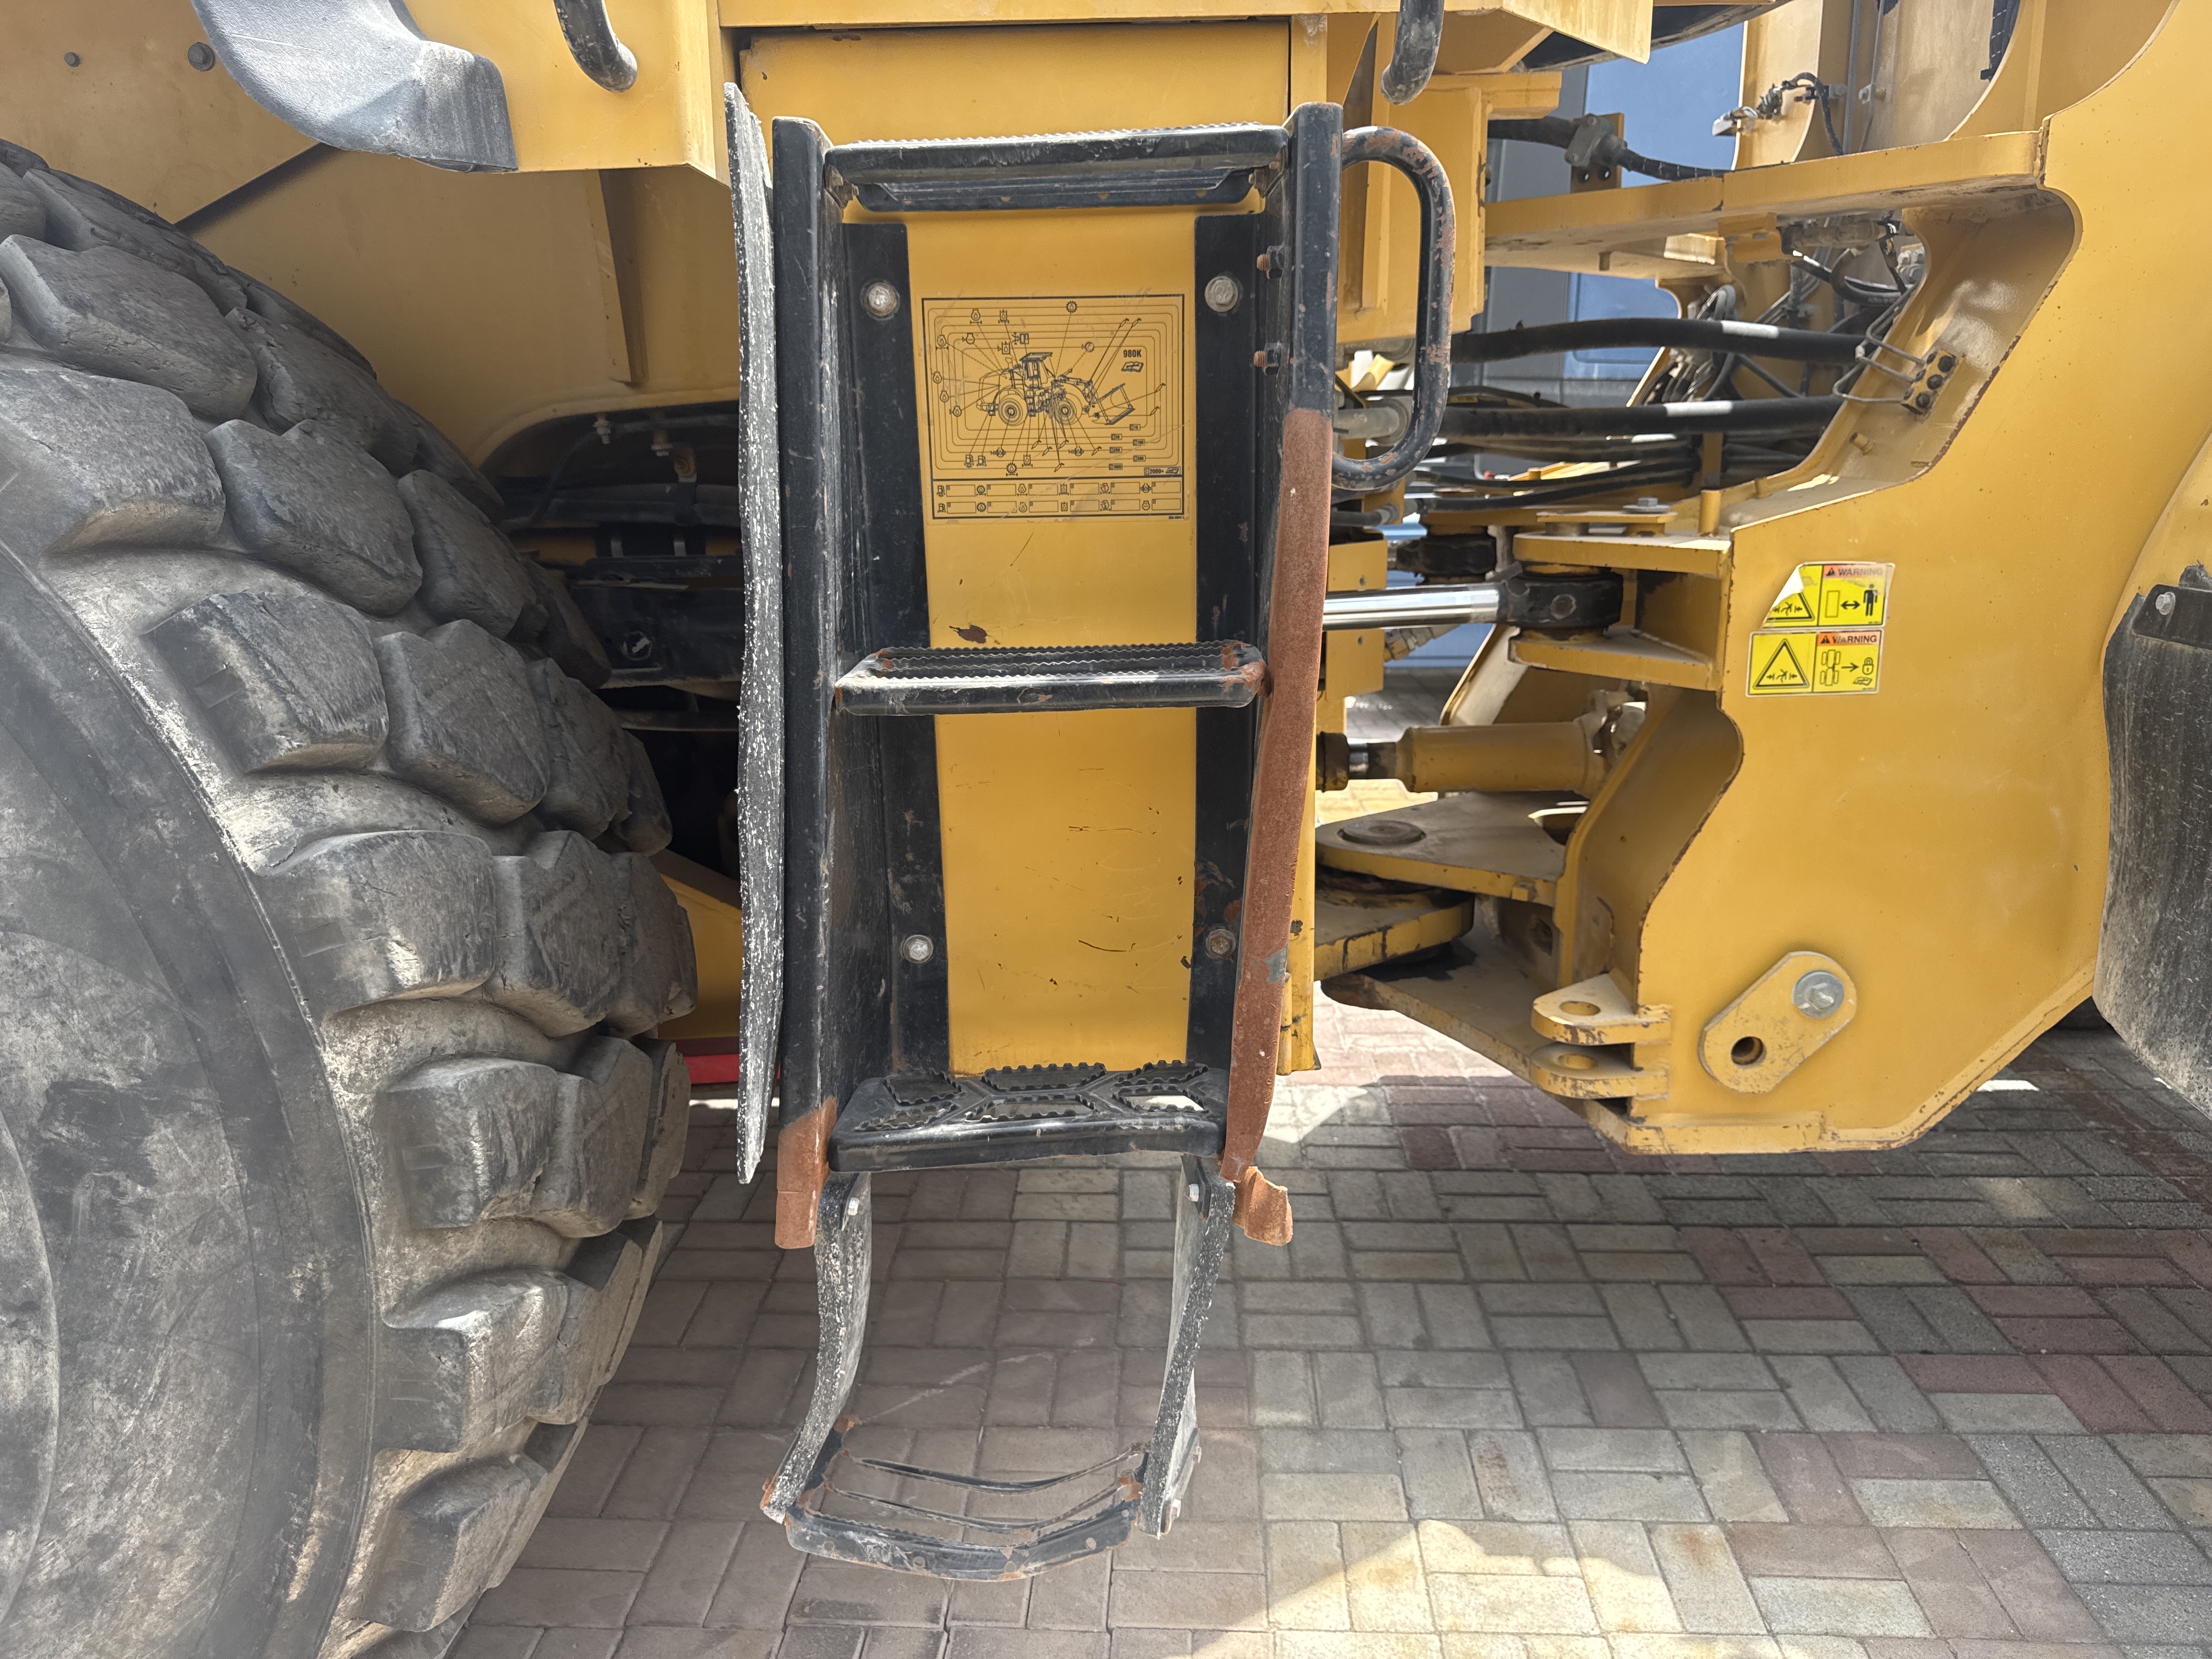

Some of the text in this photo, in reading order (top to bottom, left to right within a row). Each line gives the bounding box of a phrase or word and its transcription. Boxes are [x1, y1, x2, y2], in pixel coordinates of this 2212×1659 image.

[1123, 349, 1142, 358] 980K
[1838, 567, 1883, 576] WARNING
[1832, 635, 1877, 644] WARNING
